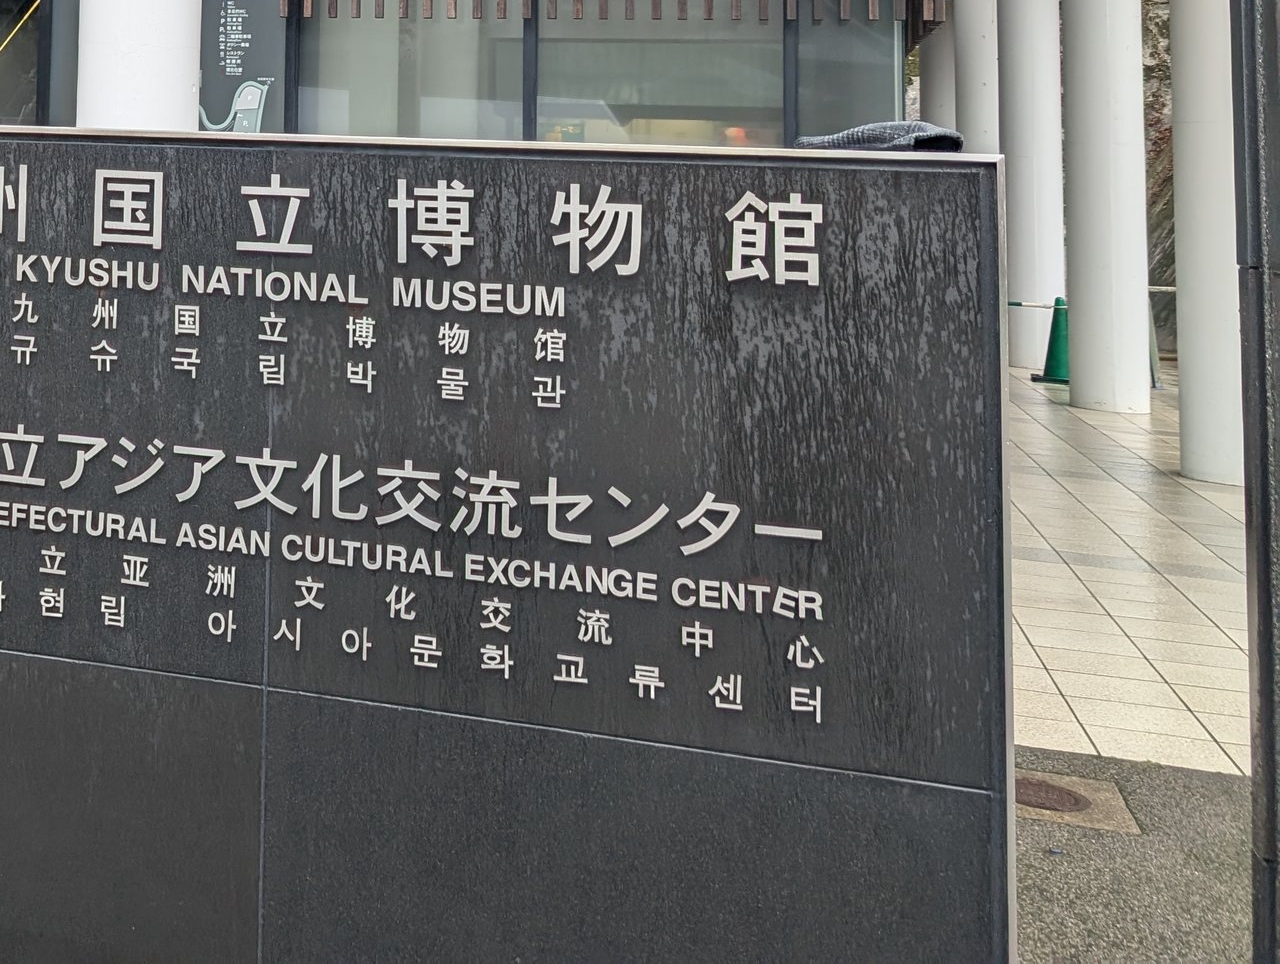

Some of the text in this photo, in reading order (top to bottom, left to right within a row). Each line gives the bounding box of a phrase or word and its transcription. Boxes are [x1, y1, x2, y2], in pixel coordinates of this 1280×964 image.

[16, 253, 566, 317] KYUSHU NATIONAL MUSEUM
[11, 293, 567, 363] 九州国立博物馆
[10, 335, 567, 409] 규슈국립박물관
[175, 522, 271, 557] ASIAN
[280, 534, 454, 579] CULTURAL
[465, 553, 658, 602] EXCHANGE
[671, 576, 823, 620] CENTER
[207, 609, 822, 724] 아시아문화교류센터
